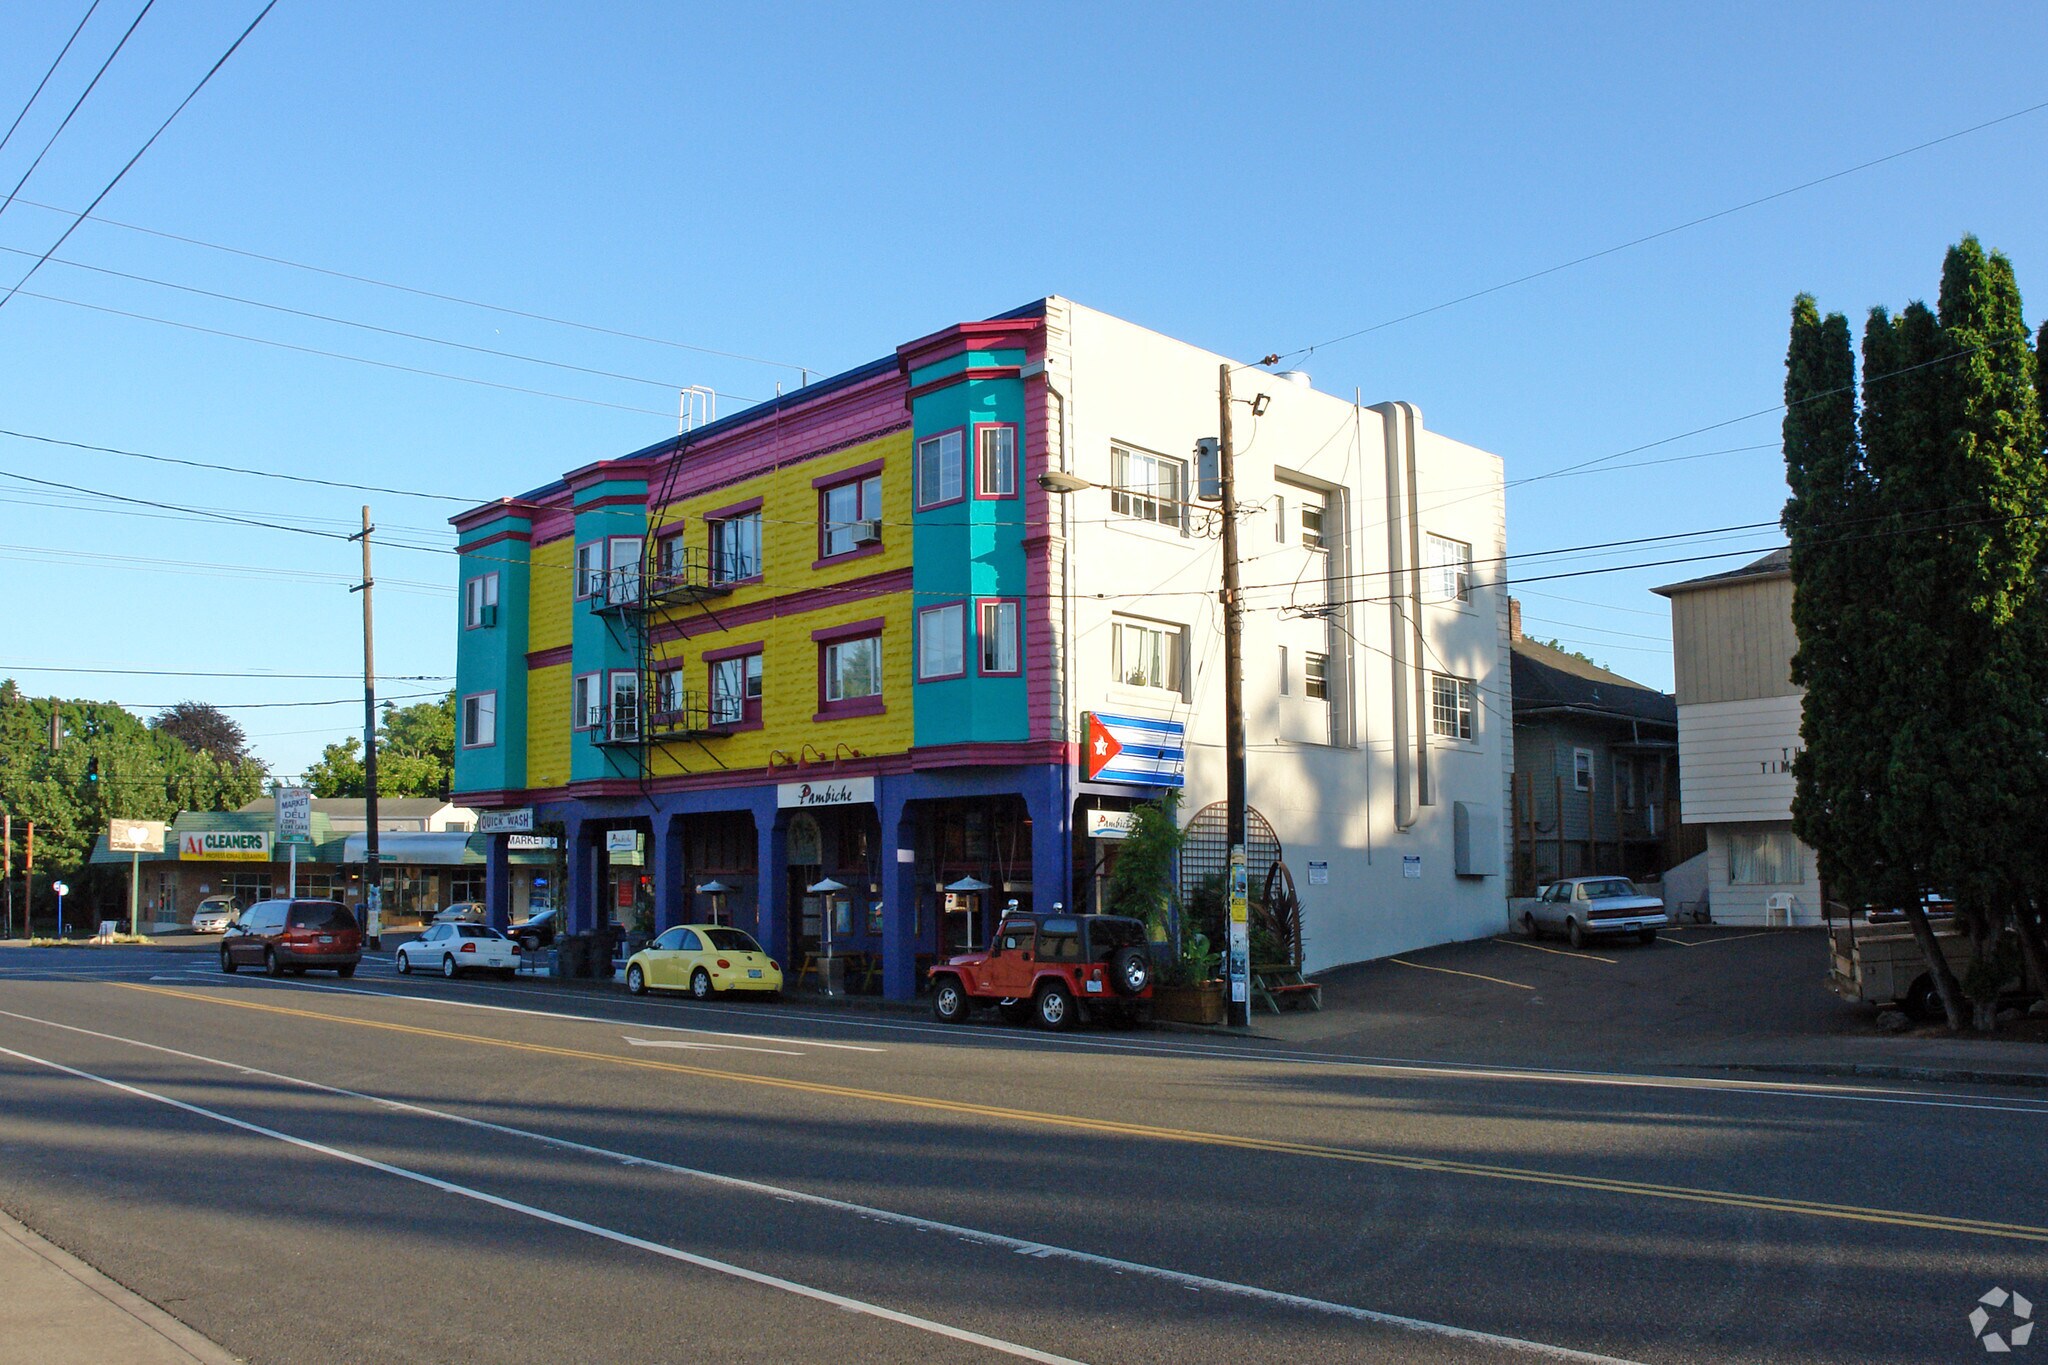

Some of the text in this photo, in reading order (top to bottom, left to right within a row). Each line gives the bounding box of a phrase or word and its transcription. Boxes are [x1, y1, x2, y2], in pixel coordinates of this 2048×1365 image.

[798, 784, 852, 805] Pambiche
[281, 798, 308, 809] MARKET
[482, 813, 529, 829] QUICK WASH
[1097, 815, 1131, 829] Pambic
[184, 835, 203, 856] A1
[205, 834, 263, 849] CLEANERS
[510, 836, 544, 845] MARKET
